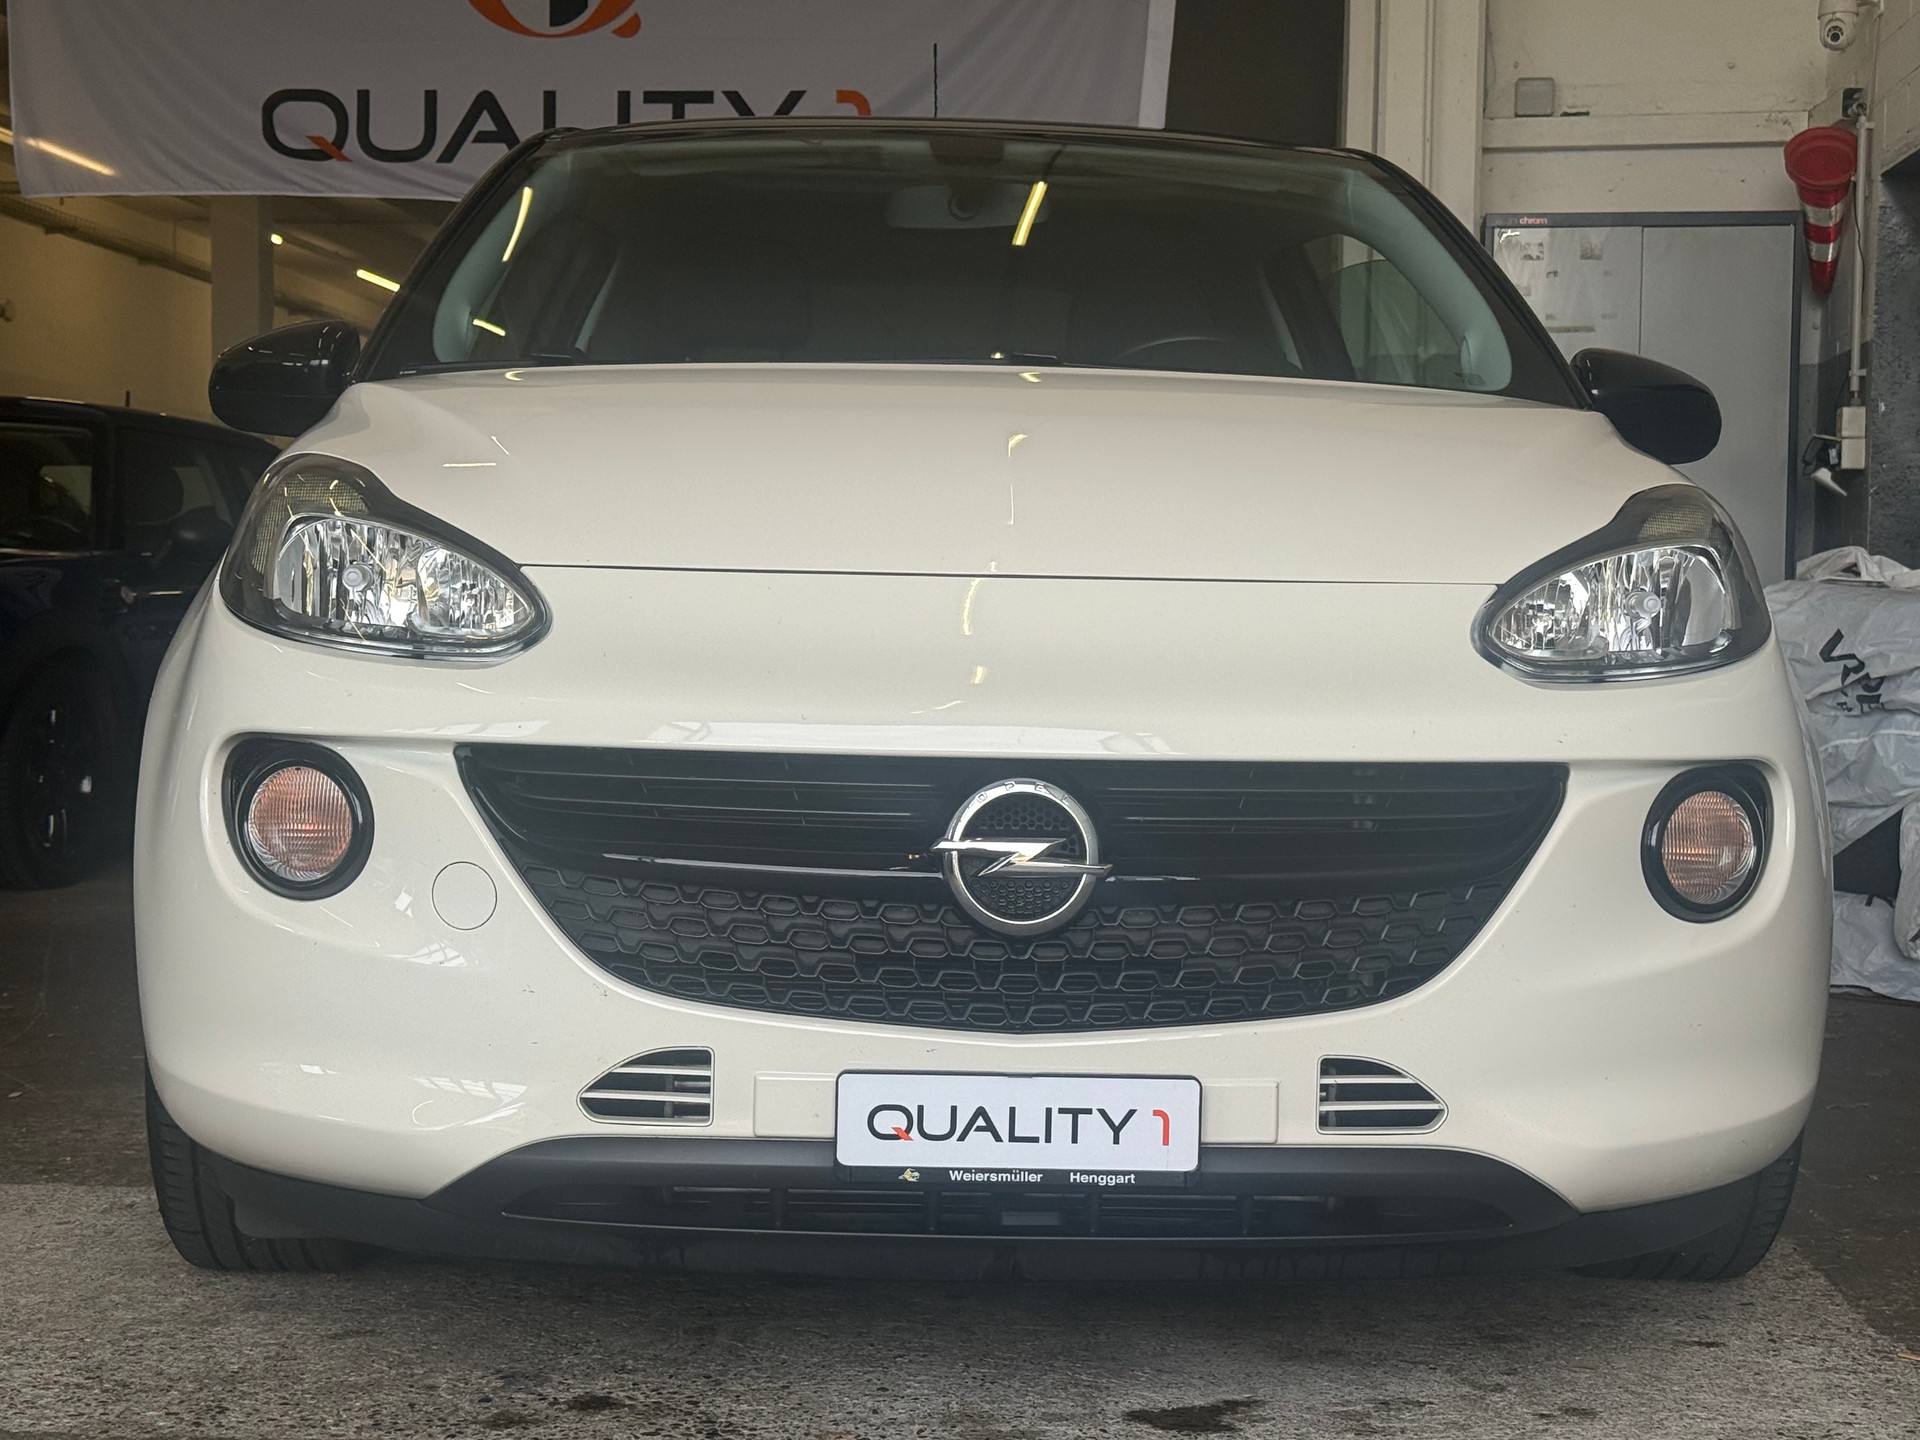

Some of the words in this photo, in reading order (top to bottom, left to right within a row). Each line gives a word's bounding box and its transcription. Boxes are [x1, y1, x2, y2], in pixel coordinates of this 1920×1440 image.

[976, 780, 1070, 805] OPEL
[867, 1104, 1138, 1145] QUALITY
[1152, 1109, 1169, 1146] 1
[949, 1169, 1043, 1183] Weiersmüller
[1070, 1172, 1136, 1186] Henggart
